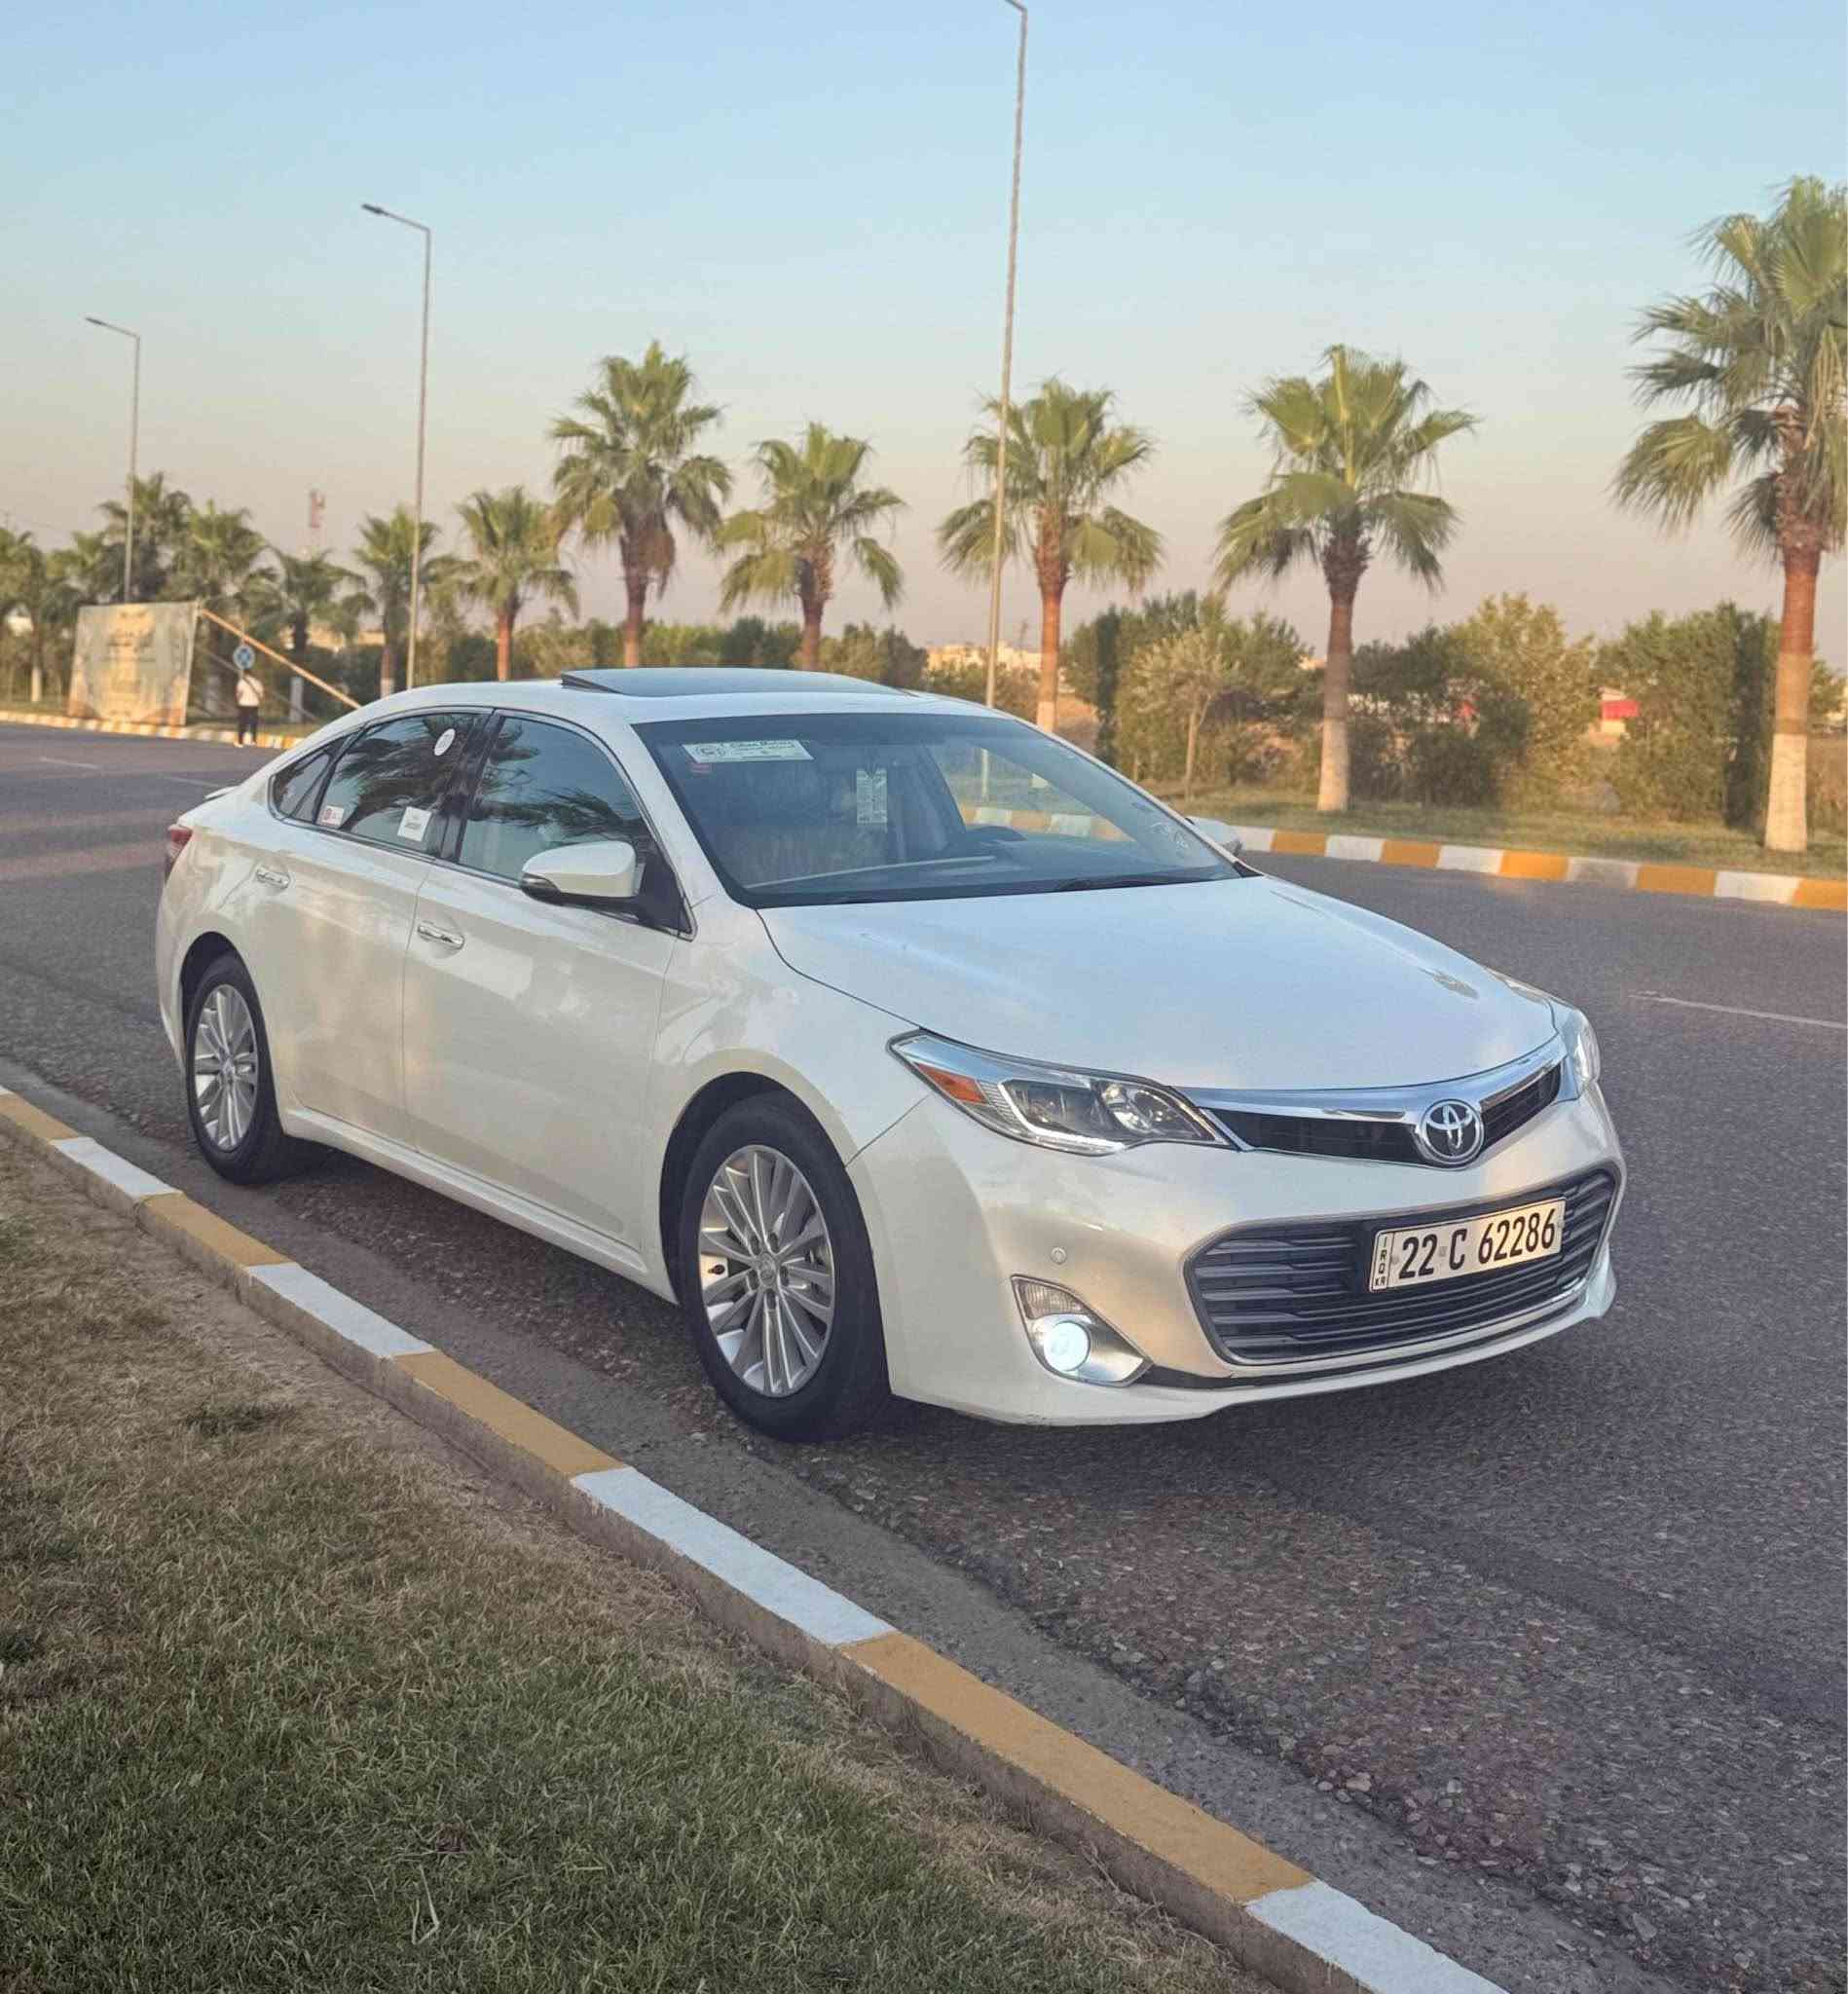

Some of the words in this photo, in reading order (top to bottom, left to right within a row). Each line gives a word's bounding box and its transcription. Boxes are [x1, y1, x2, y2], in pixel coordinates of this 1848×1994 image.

[1398, 1234, 1438, 1279] 22
[1449, 1228, 1467, 1271] C
[1478, 1208, 1556, 1264] 62286
